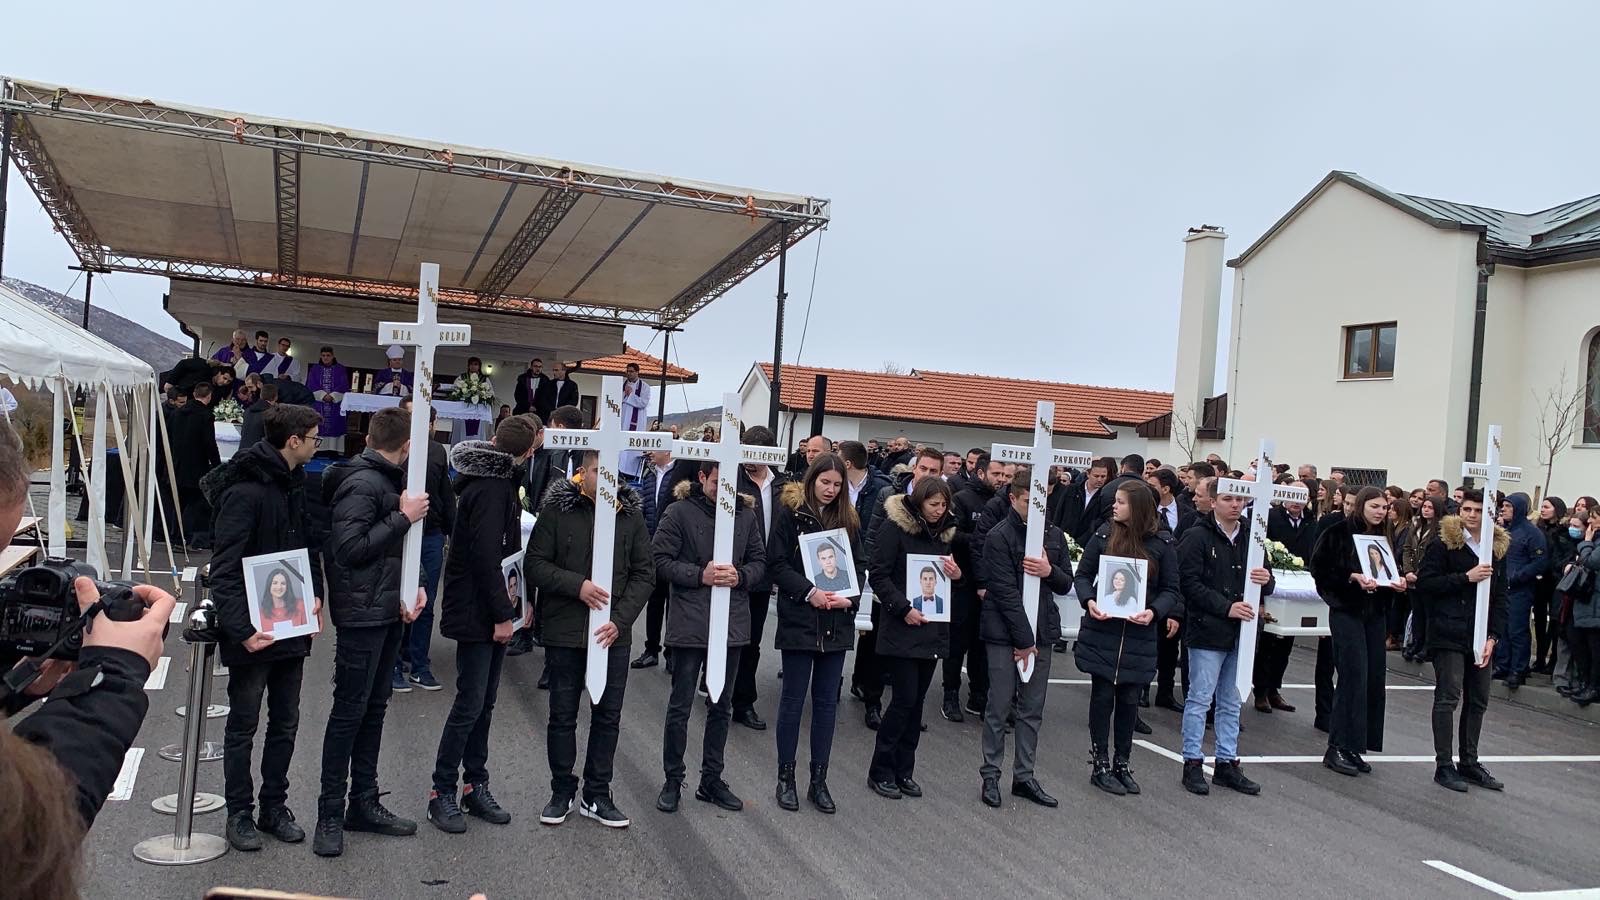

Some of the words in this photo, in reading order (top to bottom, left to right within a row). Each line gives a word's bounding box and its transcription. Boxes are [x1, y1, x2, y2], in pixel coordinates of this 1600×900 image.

[392, 329, 411, 341] MIA
[439, 331, 466, 342] SOLDO
[606, 394, 620, 417] INRI
[552, 435, 589, 446] STIPE
[680, 446, 710, 457] IVAN
[1001, 449, 1032, 461] STIPE
[599, 465, 616, 488] 2001
[599, 487, 616, 509] 2021
[1032, 496, 1046, 516] 2021
[720, 497, 735, 518] 2021
[16, 644, 34, 652] Canon
